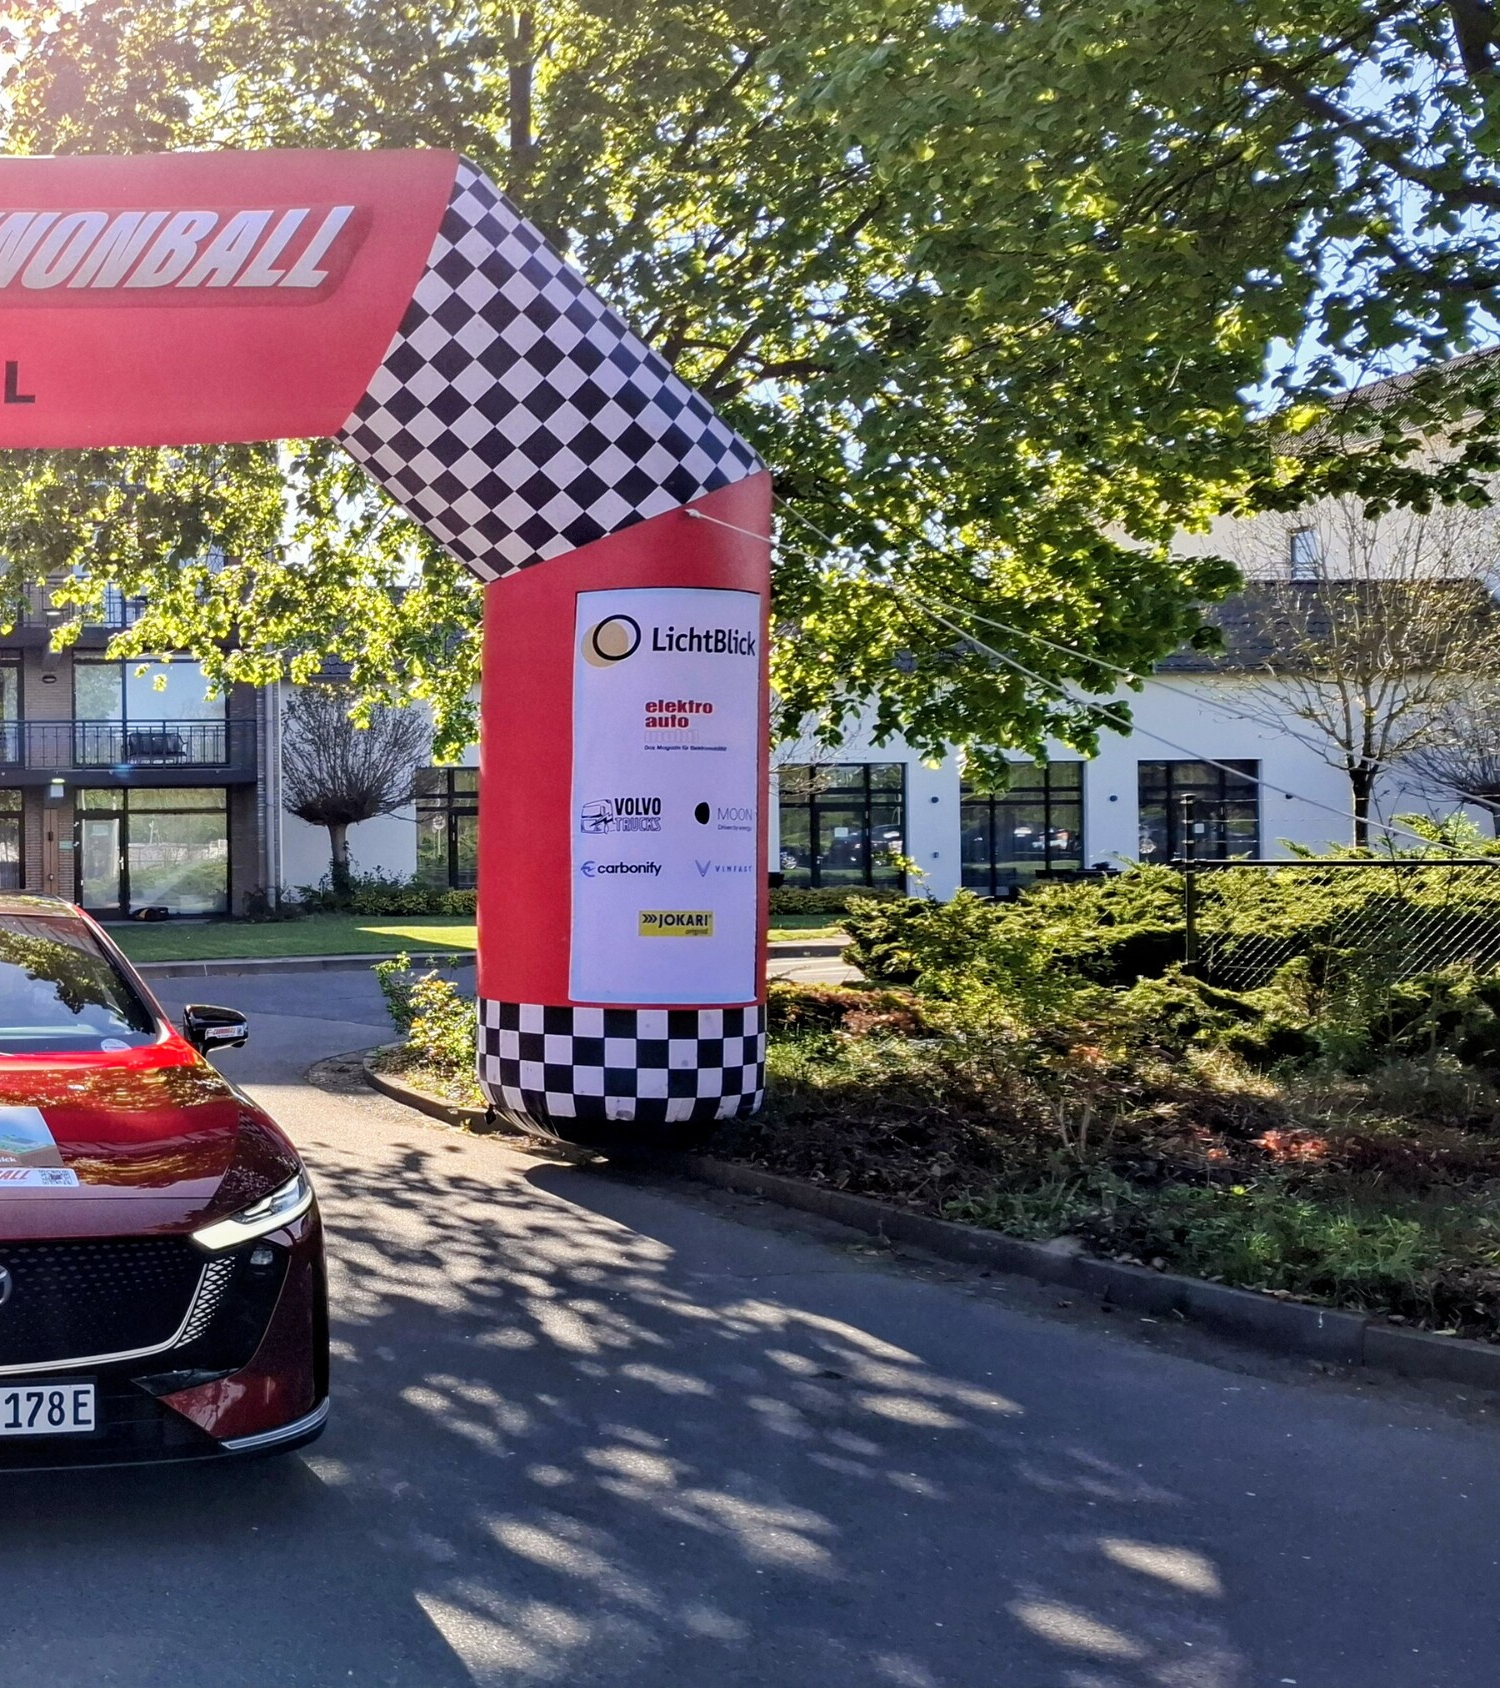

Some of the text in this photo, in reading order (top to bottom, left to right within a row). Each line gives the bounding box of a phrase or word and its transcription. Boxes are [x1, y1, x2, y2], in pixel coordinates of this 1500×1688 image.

[651, 626, 757, 657] LichtBlick
[644, 700, 713, 715] elektro
[644, 714, 690, 729] auto
[614, 797, 662, 816] VOLVO
[717, 807, 753, 821] MOON
[614, 817, 662, 832] TRUCKS
[597, 861, 662, 877] carbonify
